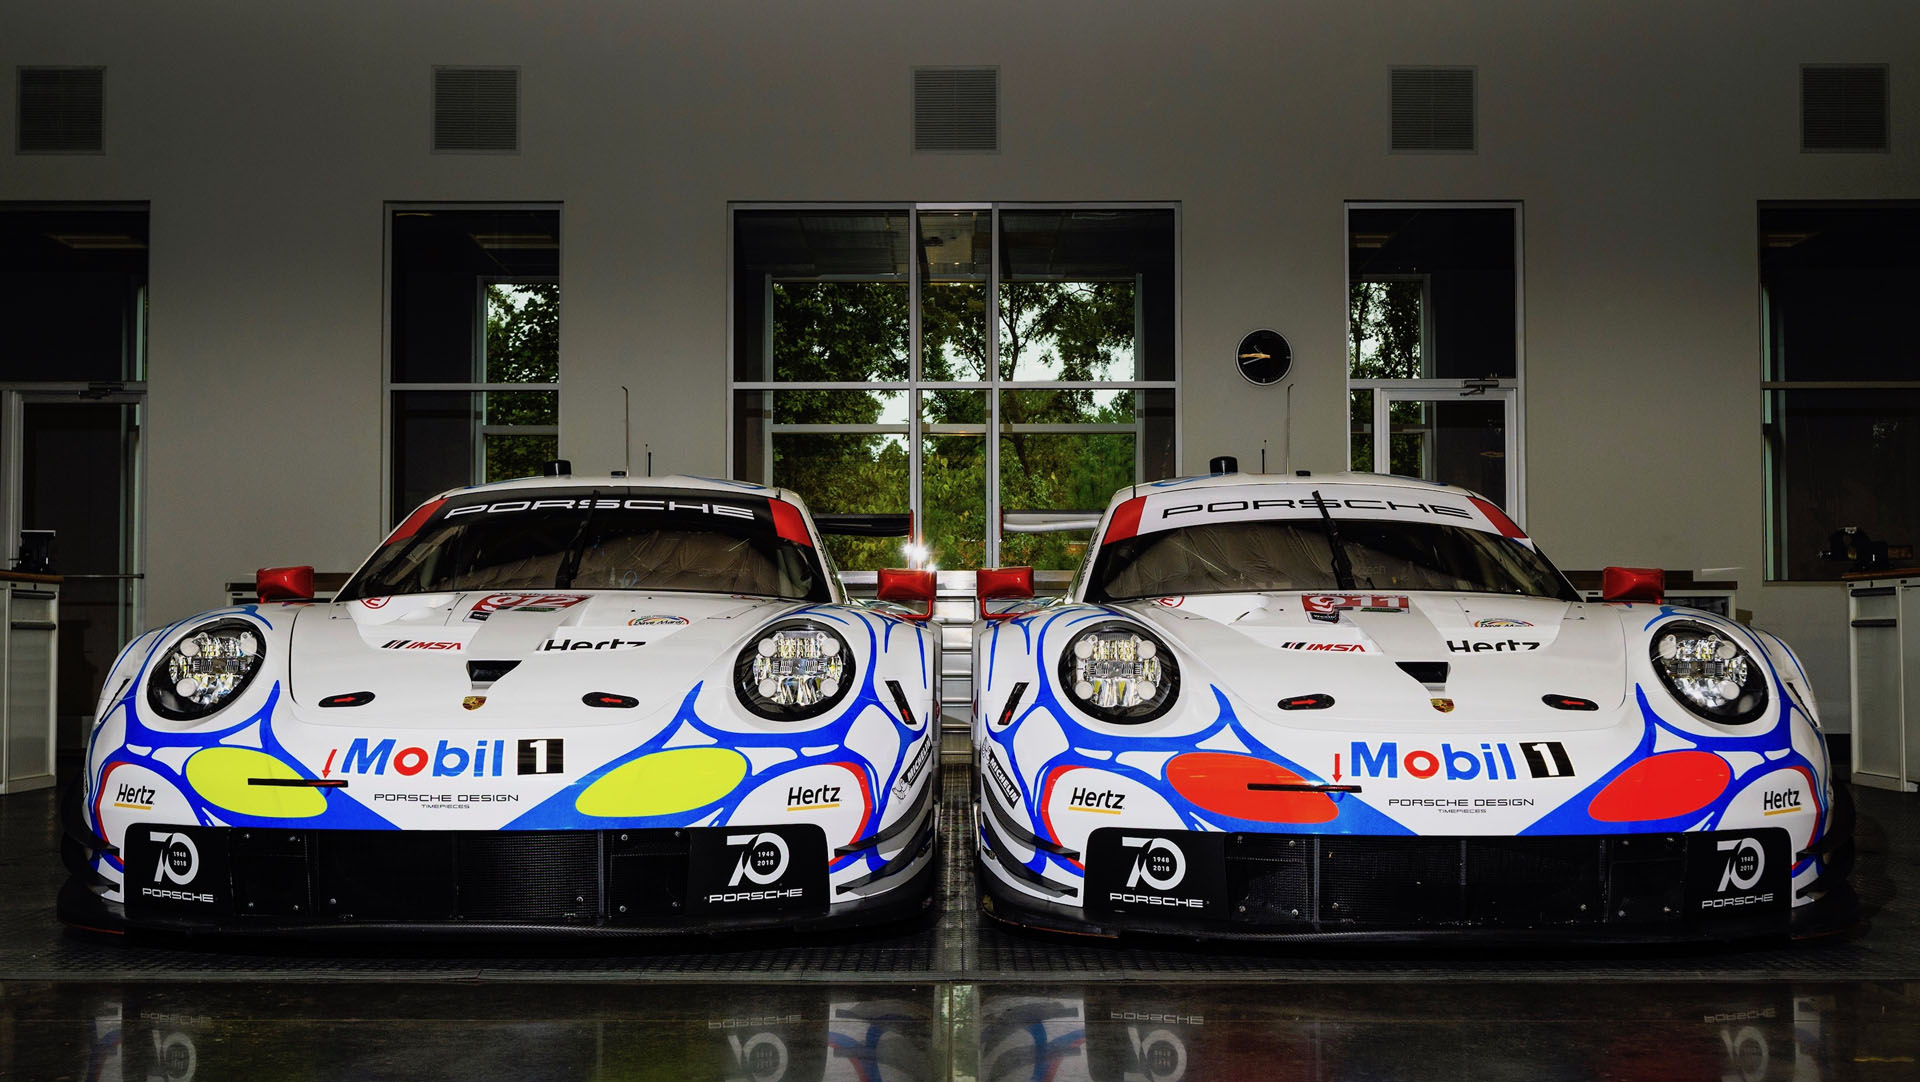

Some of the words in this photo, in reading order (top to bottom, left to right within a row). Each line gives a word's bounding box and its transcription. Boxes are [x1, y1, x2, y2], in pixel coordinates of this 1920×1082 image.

[443, 499, 755, 520] PORSCHE
[1162, 499, 1473, 520] PORSCHE
[482, 595, 578, 611] 912
[1309, 596, 1400, 612] 911
[405, 641, 461, 651] IMSA
[544, 639, 646, 651] Hertz
[1306, 643, 1366, 652] IMSA
[1446, 639, 1540, 652] Hertz
[341, 738, 505, 777] Mobil
[1351, 741, 1517, 780] Mobil
[990, 757, 1019, 803] MICHELIN
[116, 784, 155, 805] Hertz
[374, 793, 452, 802] PORSCHE
[457, 794, 519, 802] DESIGN
[787, 785, 840, 806] Hertz
[1070, 787, 1125, 809] Hertz
[1388, 798, 1468, 807] PORSCHE
[1474, 798, 1534, 807] DESIGN
[1764, 788, 1801, 810] Hertz
[150, 831, 199, 885] 70
[727, 832, 790, 887] 70
[1122, 836, 1186, 891] 70
[1717, 837, 1765, 892] 70
[142, 887, 214, 903] PORSCHE
[709, 888, 803, 903] PORSCHE
[1109, 892, 1204, 908] PORSCHE
[1701, 893, 1774, 909] PORSCHE
